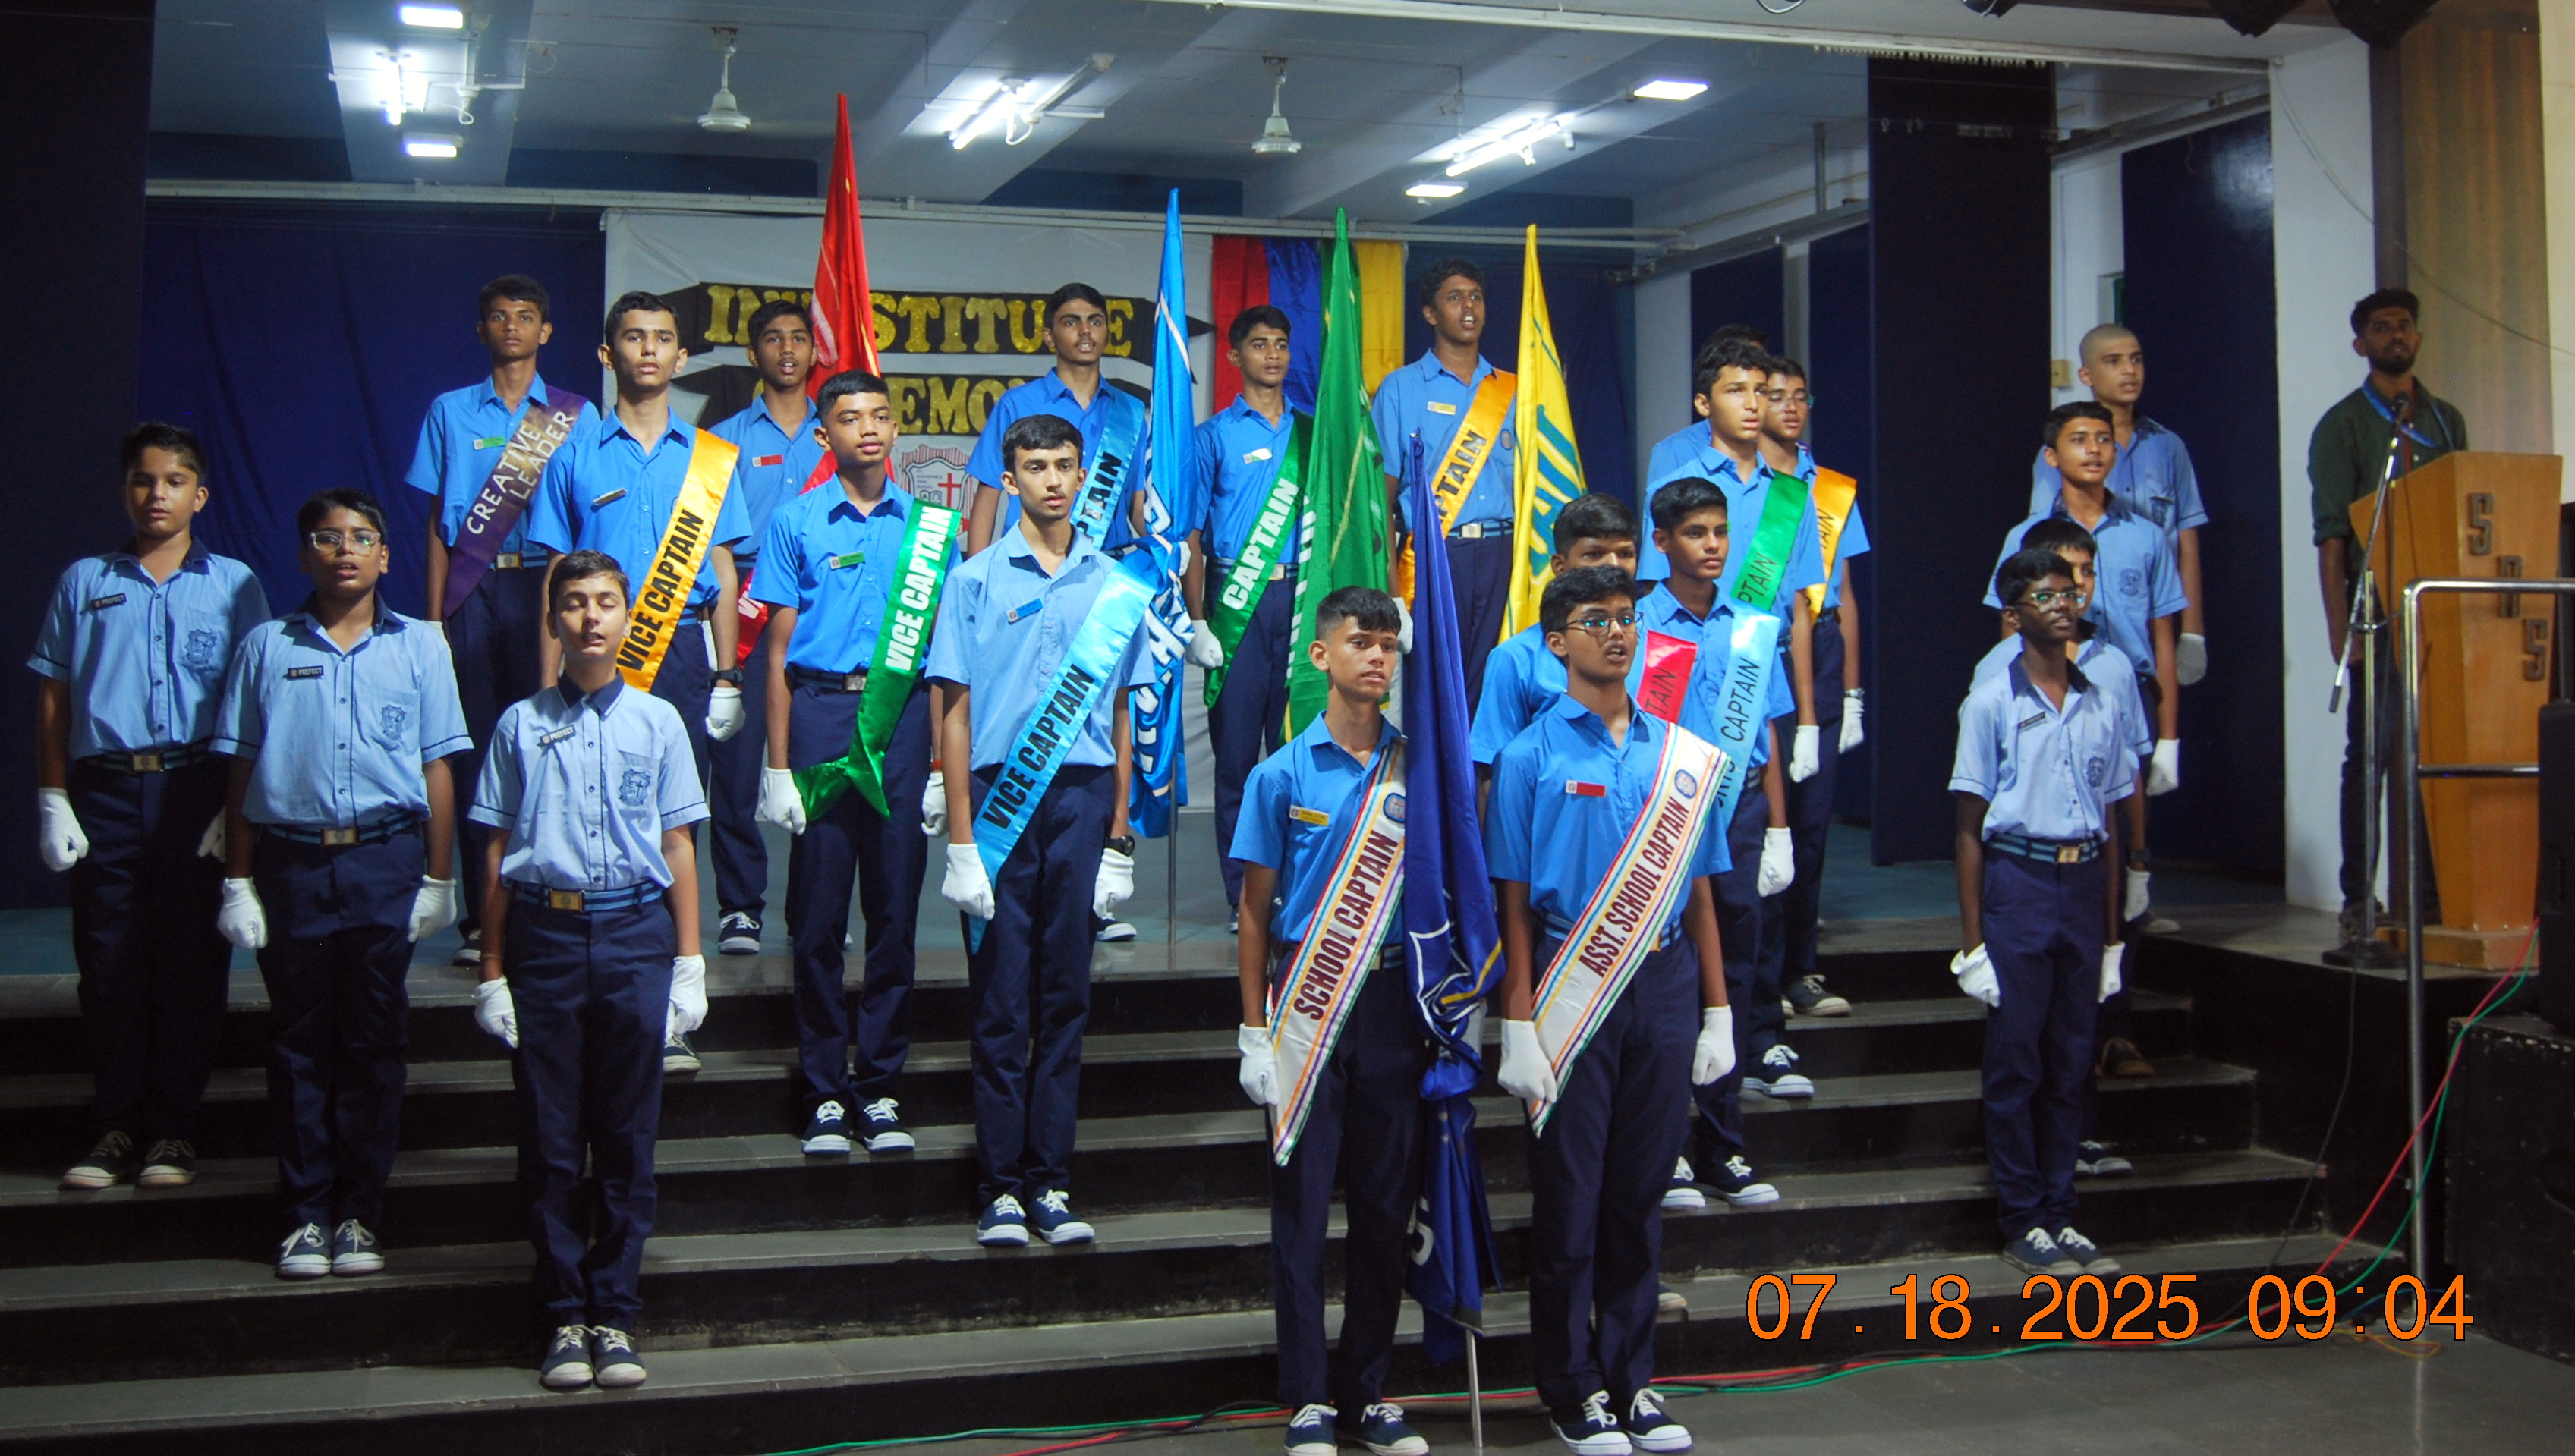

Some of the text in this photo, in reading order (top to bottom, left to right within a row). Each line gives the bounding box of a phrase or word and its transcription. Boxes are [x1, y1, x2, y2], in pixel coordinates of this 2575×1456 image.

[467, 424, 540, 534] CREATIVE
[509, 410, 574, 500] LEADER
[1076, 451, 1122, 543] PTAIN
[1435, 429, 1487, 519] PTAIN
[616, 509, 704, 671] VICE CAPTAIN
[900, 506, 952, 611] CAPTAIN
[1223, 478, 1299, 610] CAPTAIN
[1737, 552, 1777, 603] PTAIN
[885, 609, 924, 671] VICE
[1645, 666, 1677, 715] TAIN
[1721, 658, 1761, 742] CAPTAIN
[982, 663, 1095, 831] VICE CAPTAIN
[1293, 829, 1400, 1020] SCHOOL CAPTAIN
[1579, 797, 1690, 979] ASST. SCHOOL CAPTAIN
